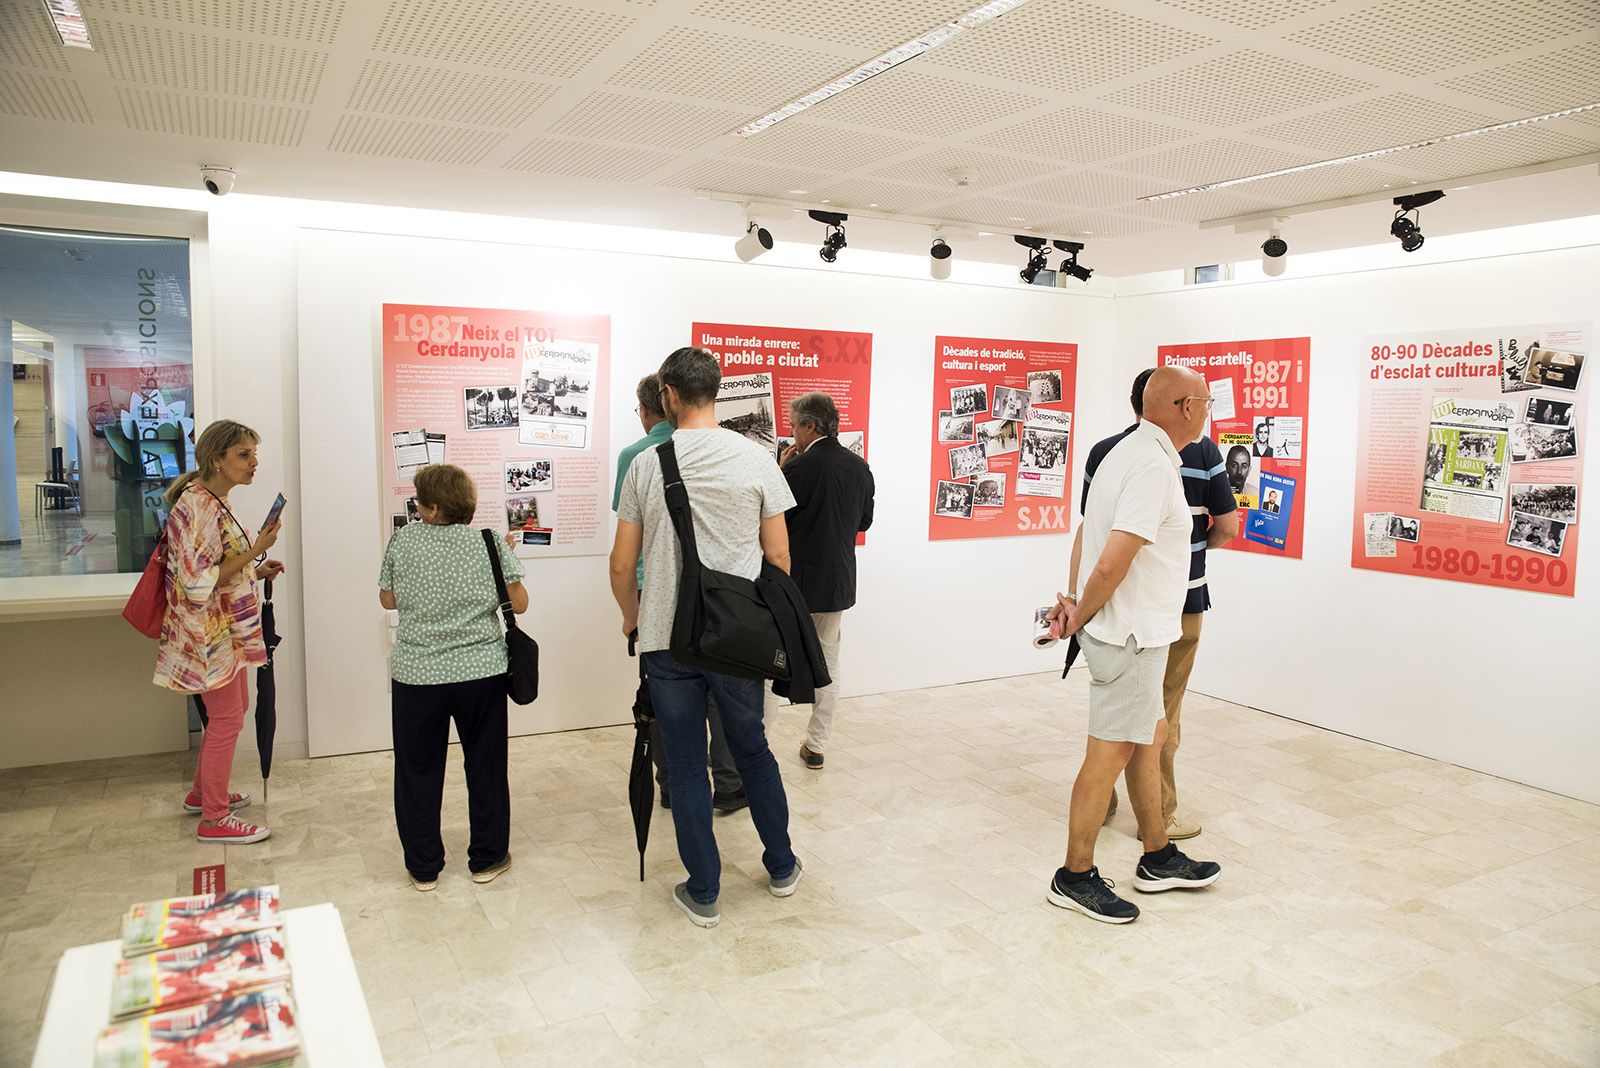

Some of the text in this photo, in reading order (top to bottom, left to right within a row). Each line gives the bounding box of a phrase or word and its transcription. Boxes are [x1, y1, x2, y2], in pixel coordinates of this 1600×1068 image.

[394, 313, 468, 343] 1987
[462, 324, 557, 342] Neix el TOT
[417, 340, 516, 362] Cerdanyola
[702, 333, 800, 350] Una mirada enrere:
[808, 335, 870, 365] S.XX
[1371, 341, 1493, 361] 80-90 Dècades
[724, 351, 763, 367] poble
[767, 355, 775, 366] a
[778, 353, 819, 368] ciutat
[943, 346, 979, 358] Dècades
[980, 348, 991, 358] de
[992, 348, 1026, 361] tradició,
[1165, 351, 1253, 367] Primers cartells
[942, 360, 1007, 373] cultura i esport
[1243, 360, 1303, 384] 1987 i
[1370, 360, 1503, 380] d'esclat cultural
[1242, 386, 1289, 409] 1991
[1017, 505, 1066, 531] S.XX
[1411, 544, 1568, 588] 1980-1990
